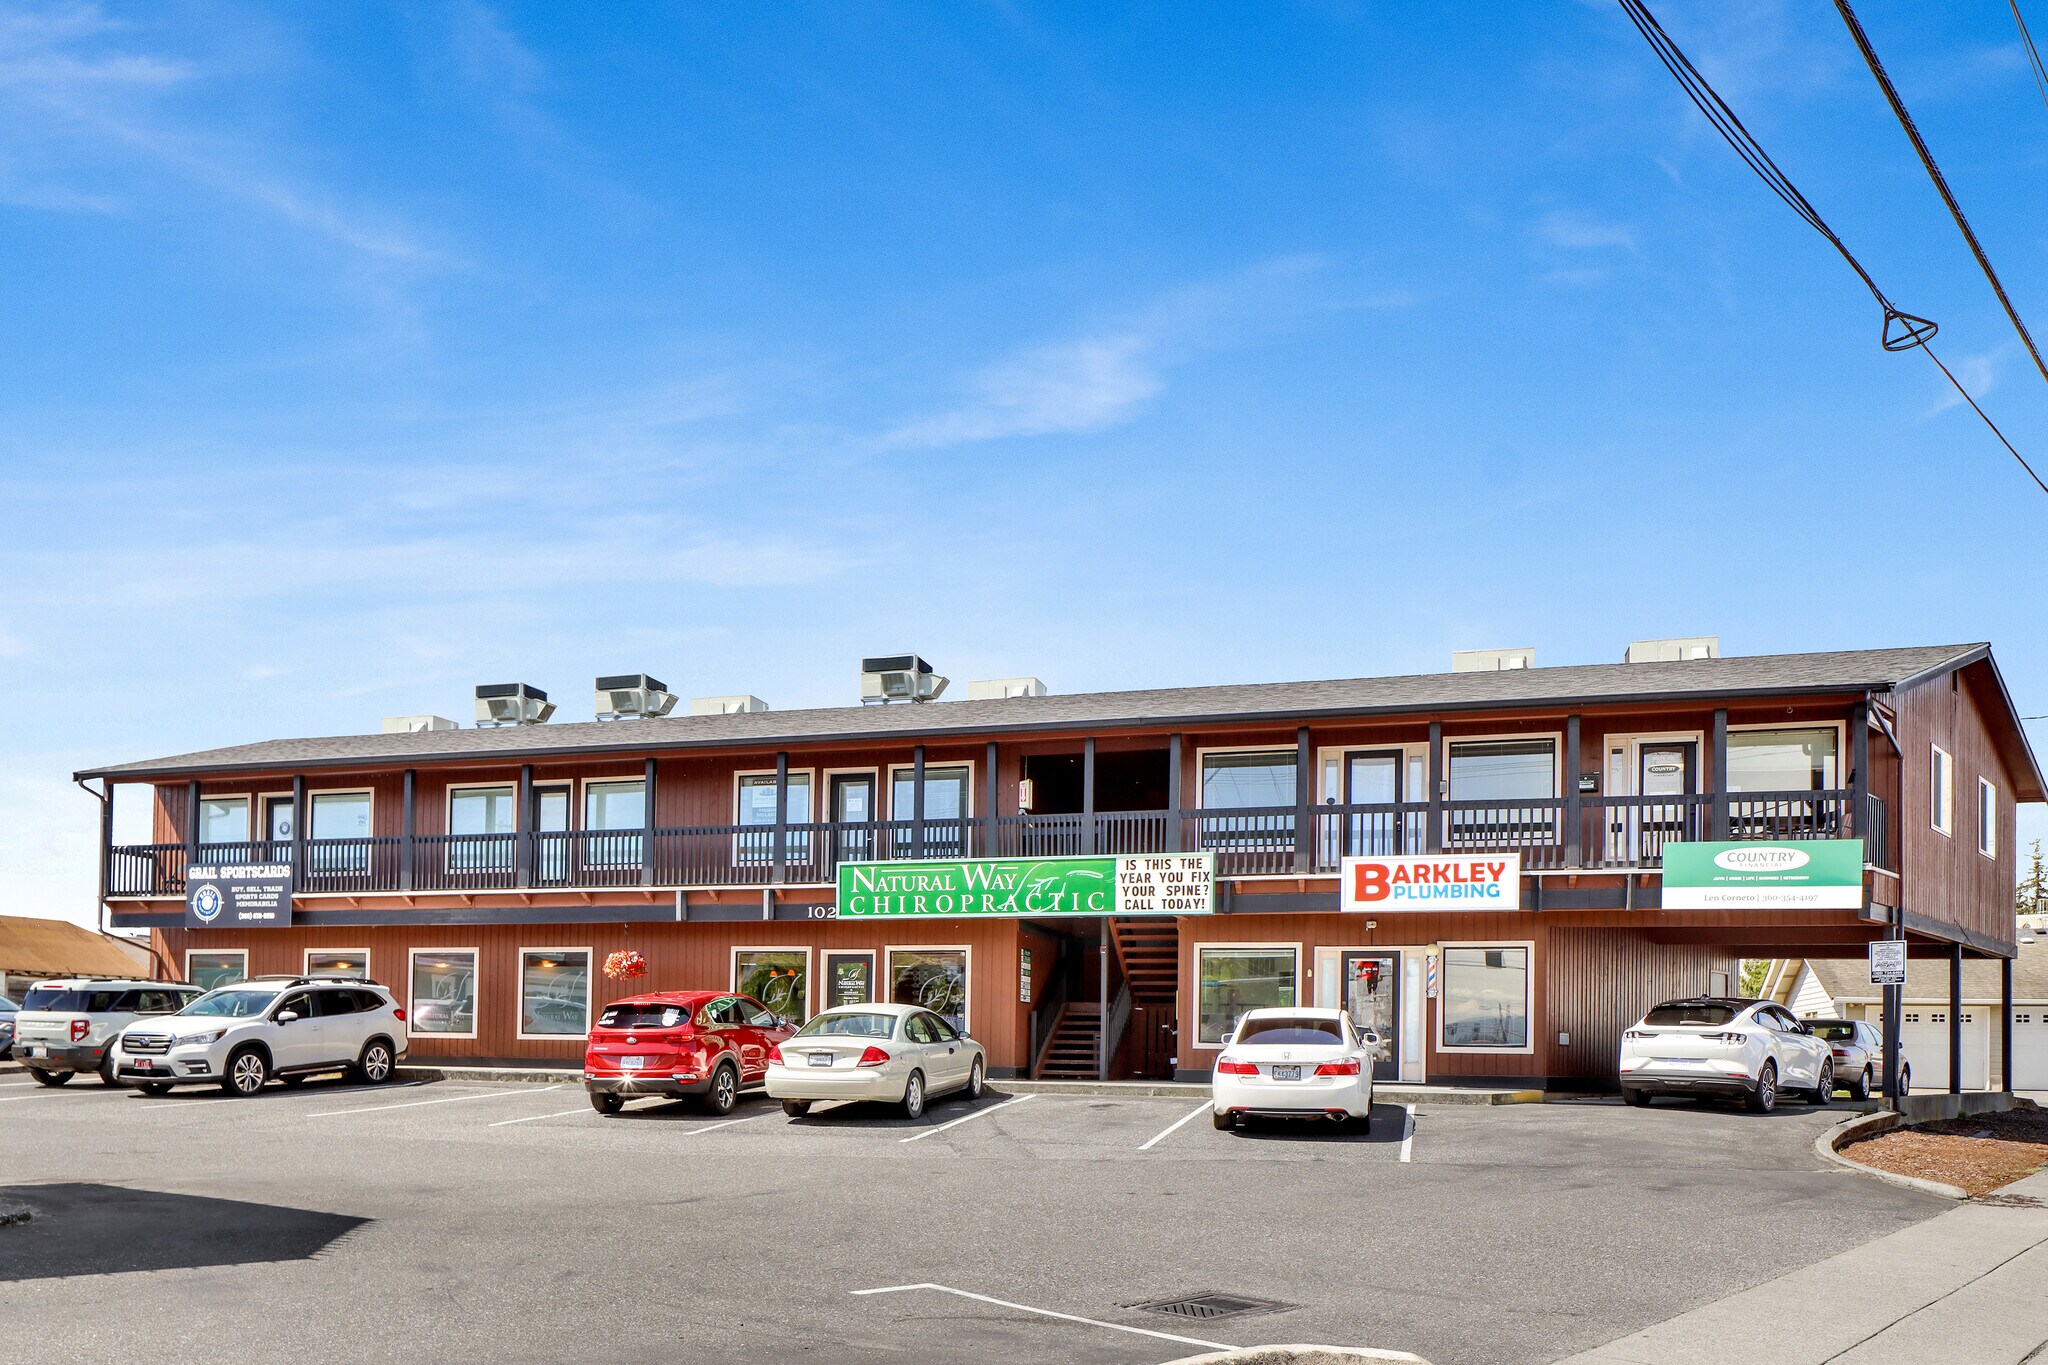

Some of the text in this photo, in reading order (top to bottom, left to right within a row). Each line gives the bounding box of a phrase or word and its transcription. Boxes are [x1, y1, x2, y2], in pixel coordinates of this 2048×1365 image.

[1126, 857, 1203, 870] IS THIS THE
[1727, 852, 1796, 863] COUNTRY
[188, 864, 291, 880] GRAIL SPORTSCARDS
[850, 863, 1018, 893] NATURAL WAY
[1120, 871, 1210, 884] YEAR YOU FIX
[1354, 862, 1506, 902] BARKLEY
[1122, 885, 1209, 897] YOUR SPINE?
[1393, 883, 1501, 900] PLUMBING
[849, 892, 1105, 914] CHIROPRACTIC
[1124, 898, 1205, 910] CALL TODAY!
[1704, 894, 1818, 902] Len Corneto 360-354-4197
